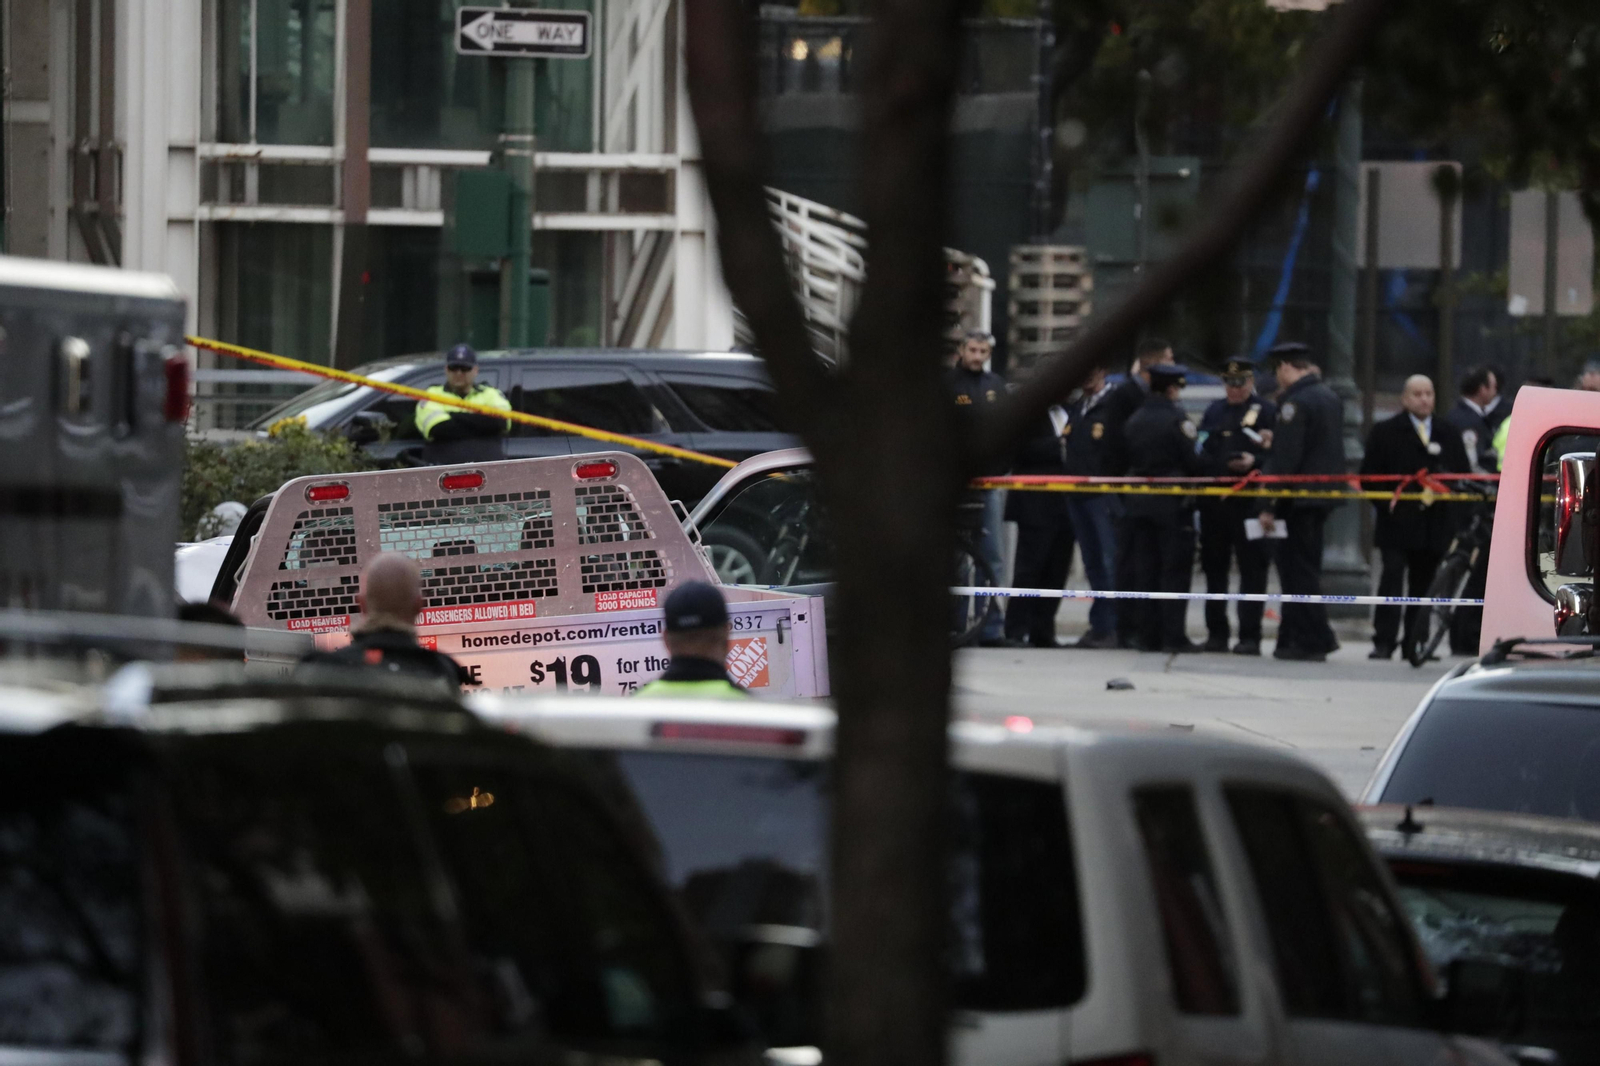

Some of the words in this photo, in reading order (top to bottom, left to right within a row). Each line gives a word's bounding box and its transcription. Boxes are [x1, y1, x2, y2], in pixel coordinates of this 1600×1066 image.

[477, 22, 514, 39] ONE
[537, 24, 578, 41] WAY
[597, 600, 618, 611] 3000
[620, 597, 656, 609] POUNDS
[599, 592, 618, 602] LOAD
[618, 589, 653, 600] CAPACITY
[291, 619, 310, 629] LOAD
[312, 616, 347, 627] HEAVIEST
[426, 607, 473, 624] PASSENGERS
[474, 604, 508, 620] ALLOWED
[509, 603, 518, 617] IN
[519, 602, 534, 616] BED
[461, 620, 662, 649] homedepot.com/rental
[726, 643, 744, 665] THE
[530, 654, 601, 697] $19
[617, 657, 640, 674] for
[644, 655, 670, 672] the
[740, 655, 768, 688] DEPOT
